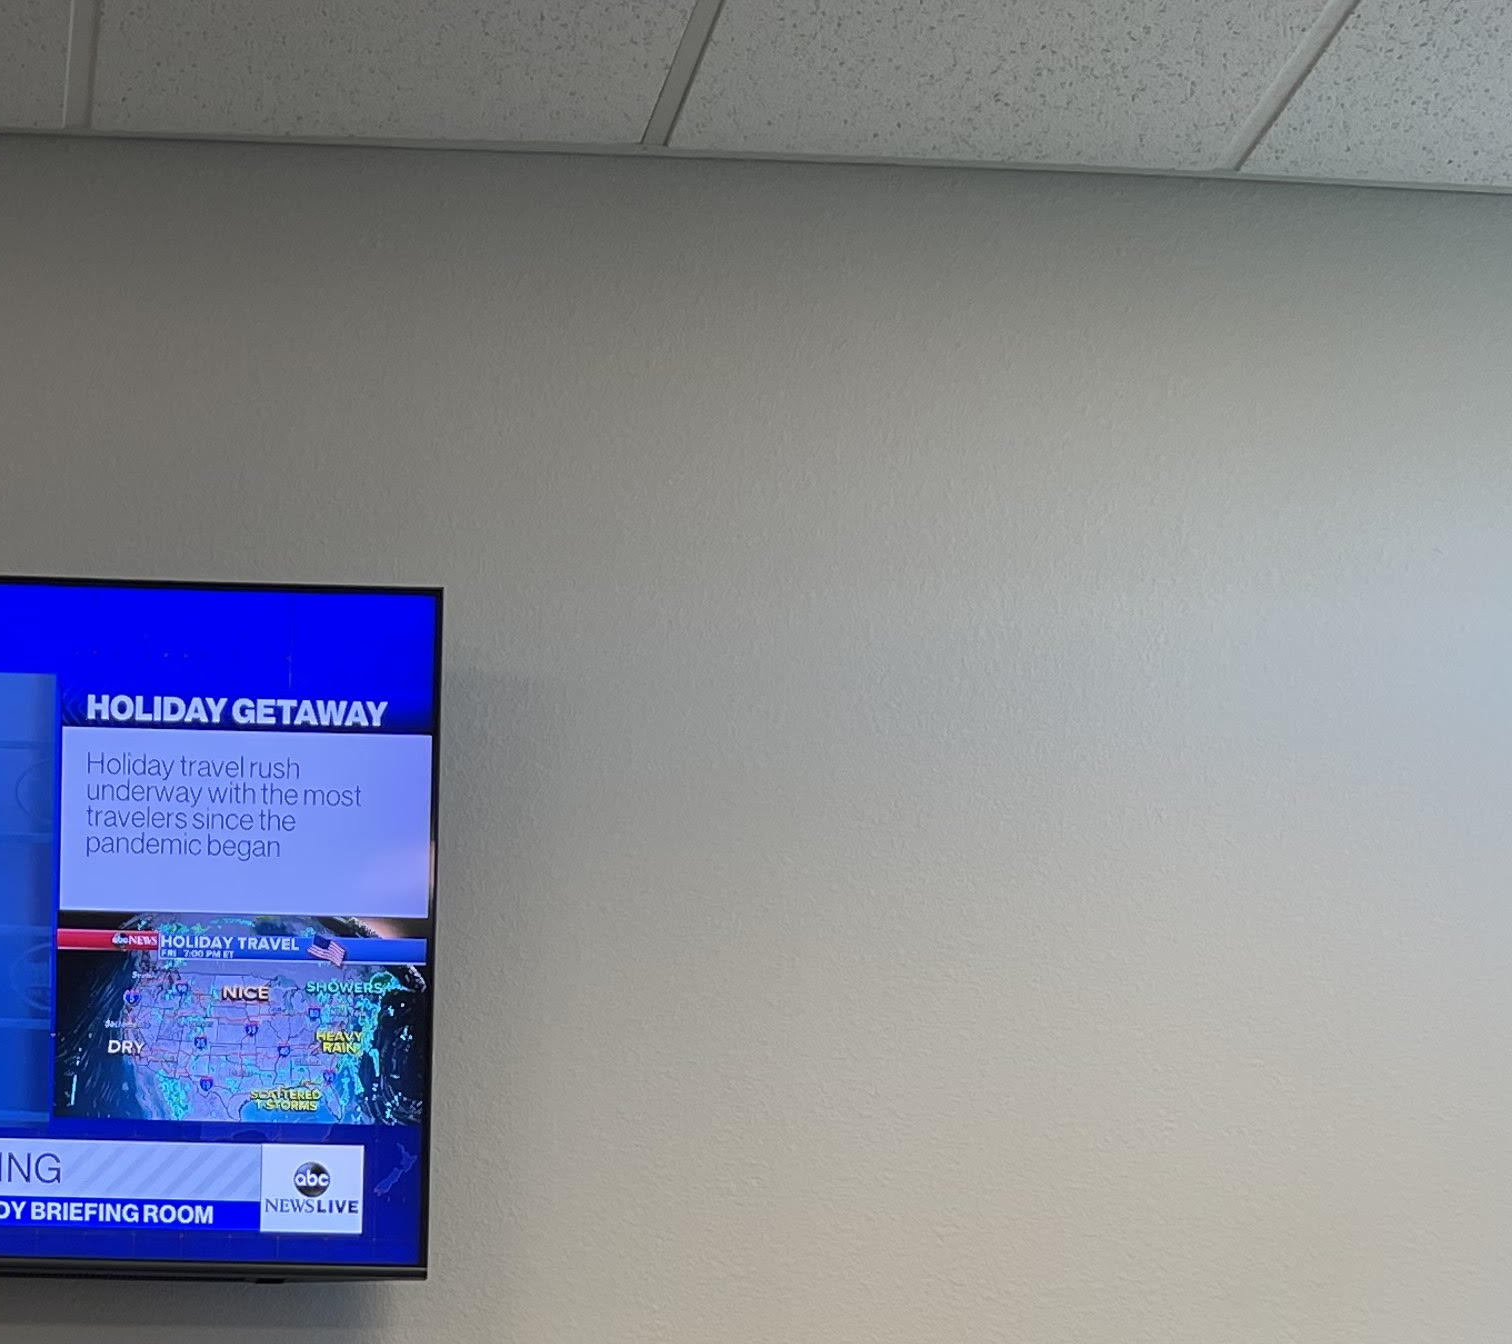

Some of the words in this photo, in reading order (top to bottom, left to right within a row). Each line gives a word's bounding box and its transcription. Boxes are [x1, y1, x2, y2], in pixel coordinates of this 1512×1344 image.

[87, 693, 228, 723] HOLIDAY
[231, 698, 389, 727] GETAWAY
[86, 751, 175, 781] Holiday
[180, 755, 245, 779] travel
[250, 757, 300, 780] rush
[86, 779, 203, 808] underway
[208, 781, 256, 805] with
[260, 783, 298, 806] the
[303, 785, 362, 808] most
[86, 805, 188, 830] travelers
[191, 807, 254, 831] since
[259, 809, 297, 832] the
[86, 832, 203, 857] pandemic
[206, 834, 281, 862] began
[160, 935, 234, 950] HOLIDAY
[237, 936, 300, 951] TRAVEL
[161, 949, 178, 958] FRI
[183, 949, 204, 959] 7:00
[205, 950, 222, 959] PM
[222, 950, 235, 960] ET
[222, 984, 271, 1001] NICE
[305, 979, 386, 995] SHOWERS
[315, 1030, 363, 1043] HEAVY
[107, 1039, 146, 1054] DRY
[321, 1041, 357, 1054] RAIN
[250, 1088, 324, 1102] SCATTERED
[294, 1168, 330, 1187] abc
[30, 1200, 140, 1224] BRIEFING
[143, 1203, 214, 1225] ROOM
